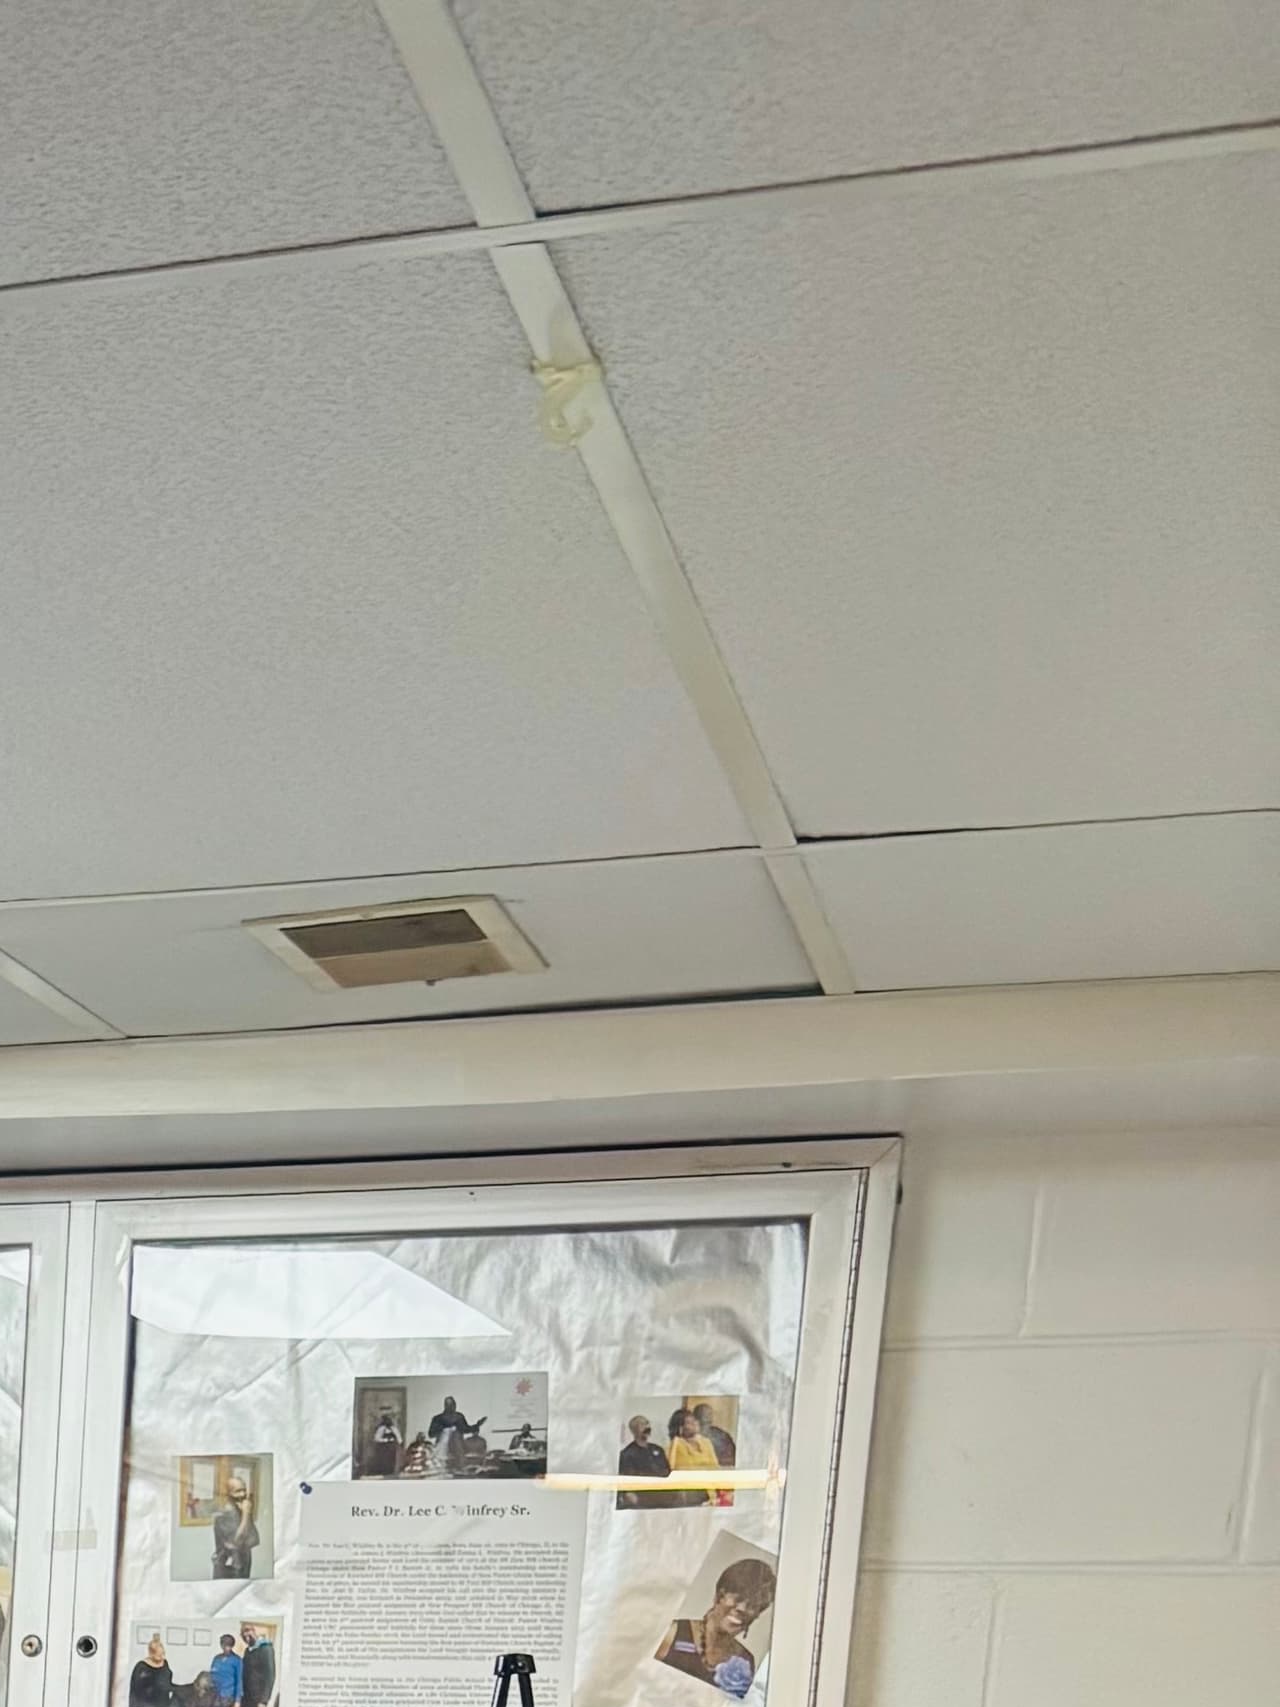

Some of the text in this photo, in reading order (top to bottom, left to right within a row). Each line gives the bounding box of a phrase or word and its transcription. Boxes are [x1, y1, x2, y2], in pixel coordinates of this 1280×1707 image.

[351, 1505, 379, 1517] Rev.
[383, 1505, 405, 1517] Dr.
[408, 1505, 432, 1517] Lee
[509, 1503, 531, 1517] Sr.
